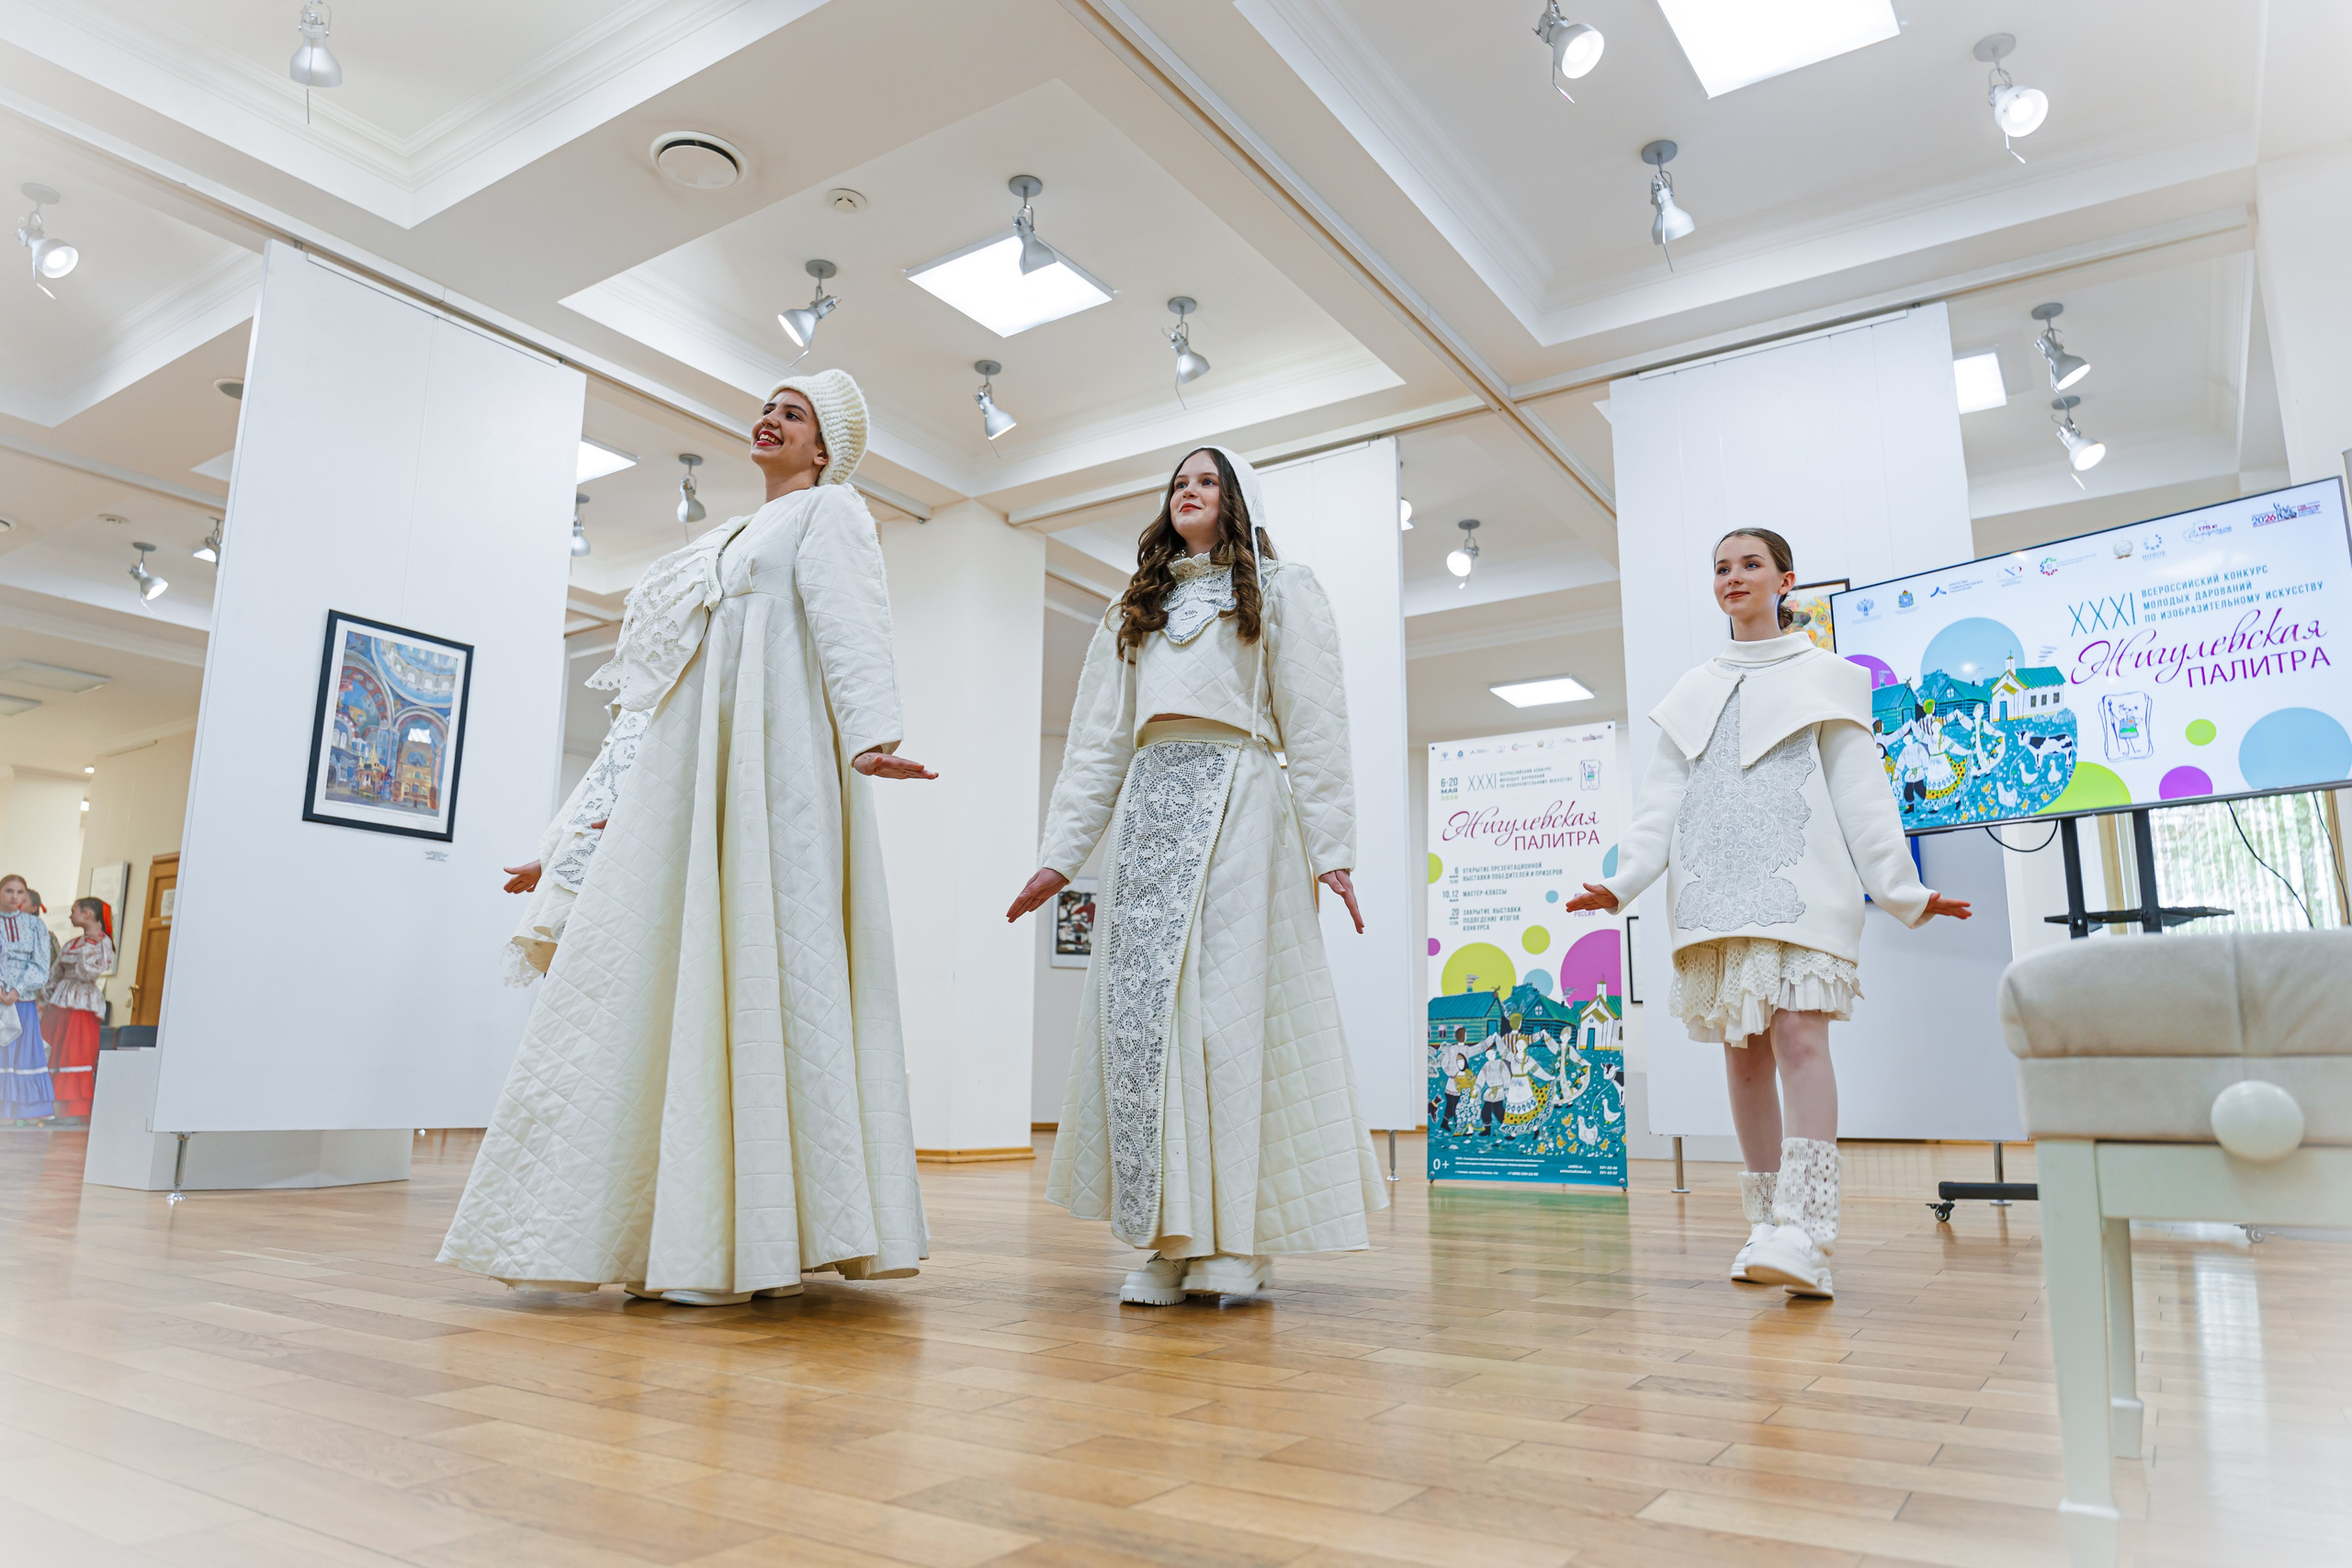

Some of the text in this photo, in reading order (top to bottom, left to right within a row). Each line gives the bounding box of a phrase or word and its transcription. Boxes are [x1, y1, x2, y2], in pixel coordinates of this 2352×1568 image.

[2252, 513, 2277, 525] 2026
[2141, 565, 2268, 598] ВСЕРОССИЙСКИЙ КОНКУРС
[2143, 581, 2253, 611] МОЛОДЫХ ДАРОВАНИЙ
[2144, 581, 2324, 624] ПО ИЗОБРАЗИТЕЛЬНОМУ ИСКУССТВУ
[2067, 592, 2136, 637] XXXI
[2070, 607, 2328, 684] Жигулевская
[2188, 646, 2332, 688] ПАЛИТРА
[1441, 777, 1458, 787] 6-20
[1467, 773, 1497, 792] XXXI
[1442, 799, 1600, 847] Жигулевская
[1514, 829, 1600, 851] ПАЛИТРА
[1454, 866, 1459, 874] 6
[1463, 862, 1542, 874] ОТКРЫТИЕ ПРЕЗЕНТАЦИОННОЙ
[1463, 874, 1490, 882] ВЫСТАВКИ
[1491, 870, 1529, 879] ПОБЕДИТЕЛЕЙ
[1534, 868, 1563, 876] ПРИЗЕРОВ
[1452, 908, 1460, 916] 20
[1463, 908, 1490, 916] ЗАКРЫТИЕ
[1463, 915, 1497, 924] ПОДВЕДЕНИЕ
[1432, 1157, 1450, 1170] 0+
